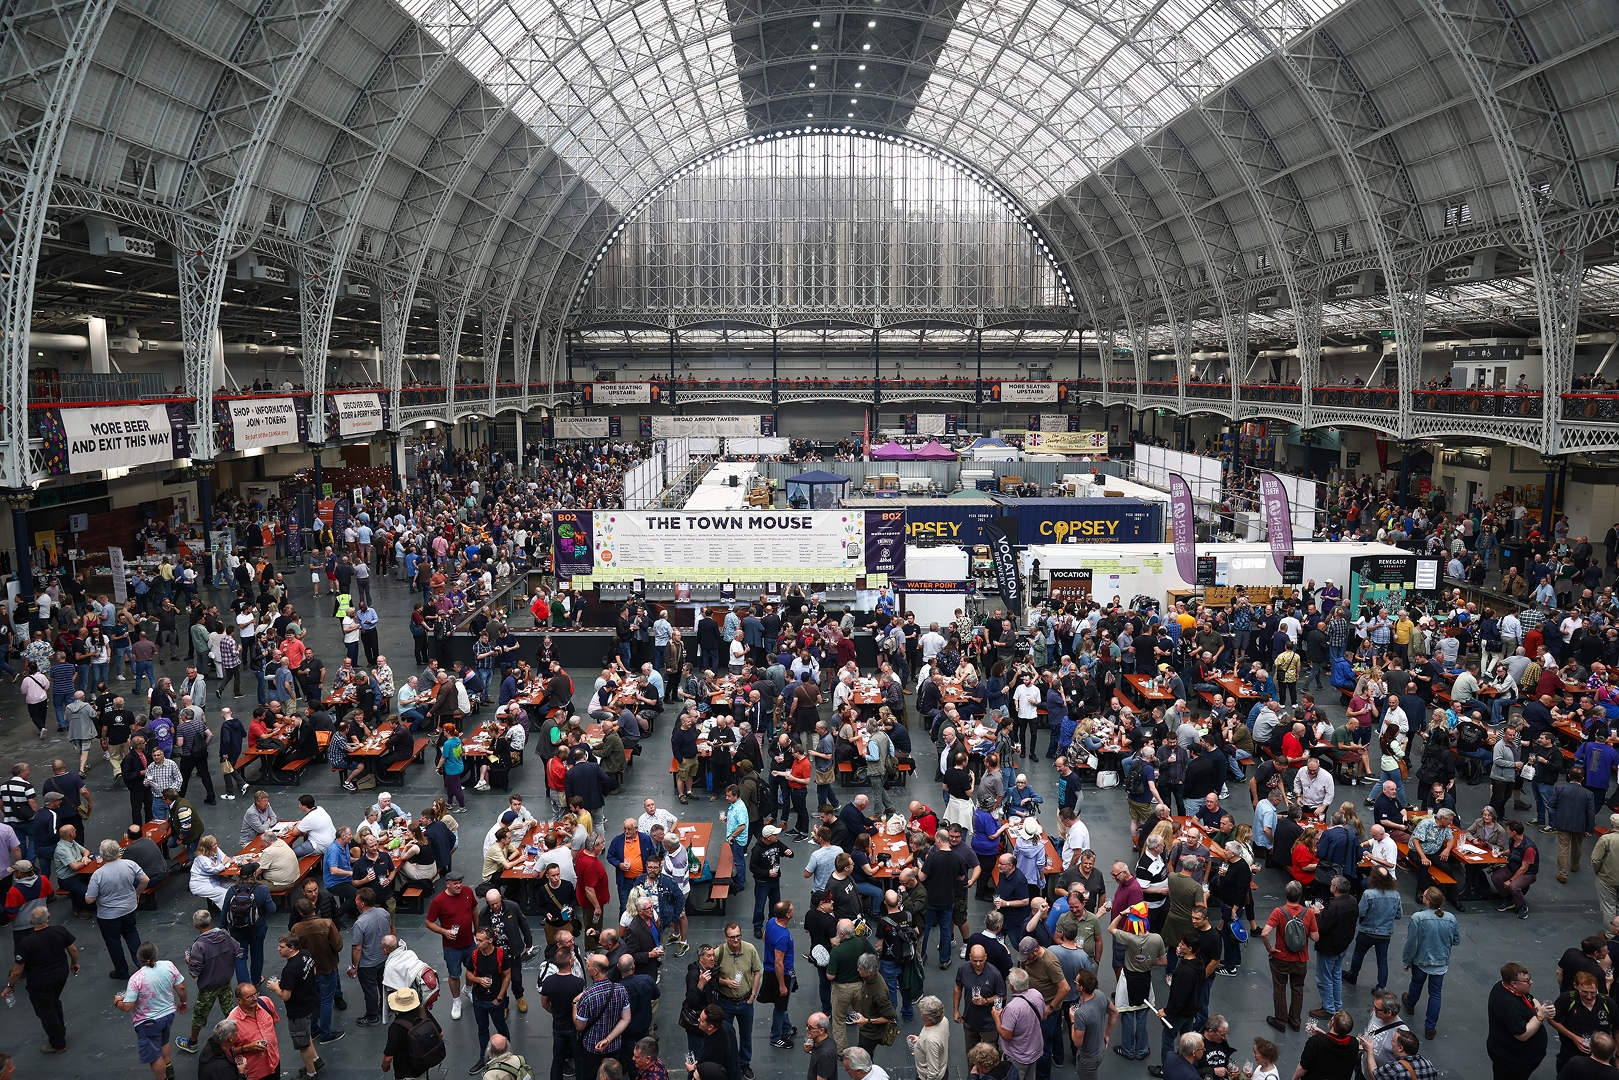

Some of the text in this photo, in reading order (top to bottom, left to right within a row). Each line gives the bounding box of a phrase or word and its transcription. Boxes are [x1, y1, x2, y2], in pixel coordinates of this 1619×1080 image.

[233, 404, 293, 417] SHOP INFORMATION
[343, 401, 363, 409] DISCOVER
[90, 420, 150, 436] MORE BEER
[247, 416, 287, 427] JOIN TOKENS
[72, 433, 170, 454] AND EXIT THIS WAY
[646, 516, 813, 530] THE TOWN MOUSE
[1040, 521, 1119, 536] COPSEY
[994, 551, 1006, 586] BREWERY
[998, 535, 1017, 599] VOCATION
